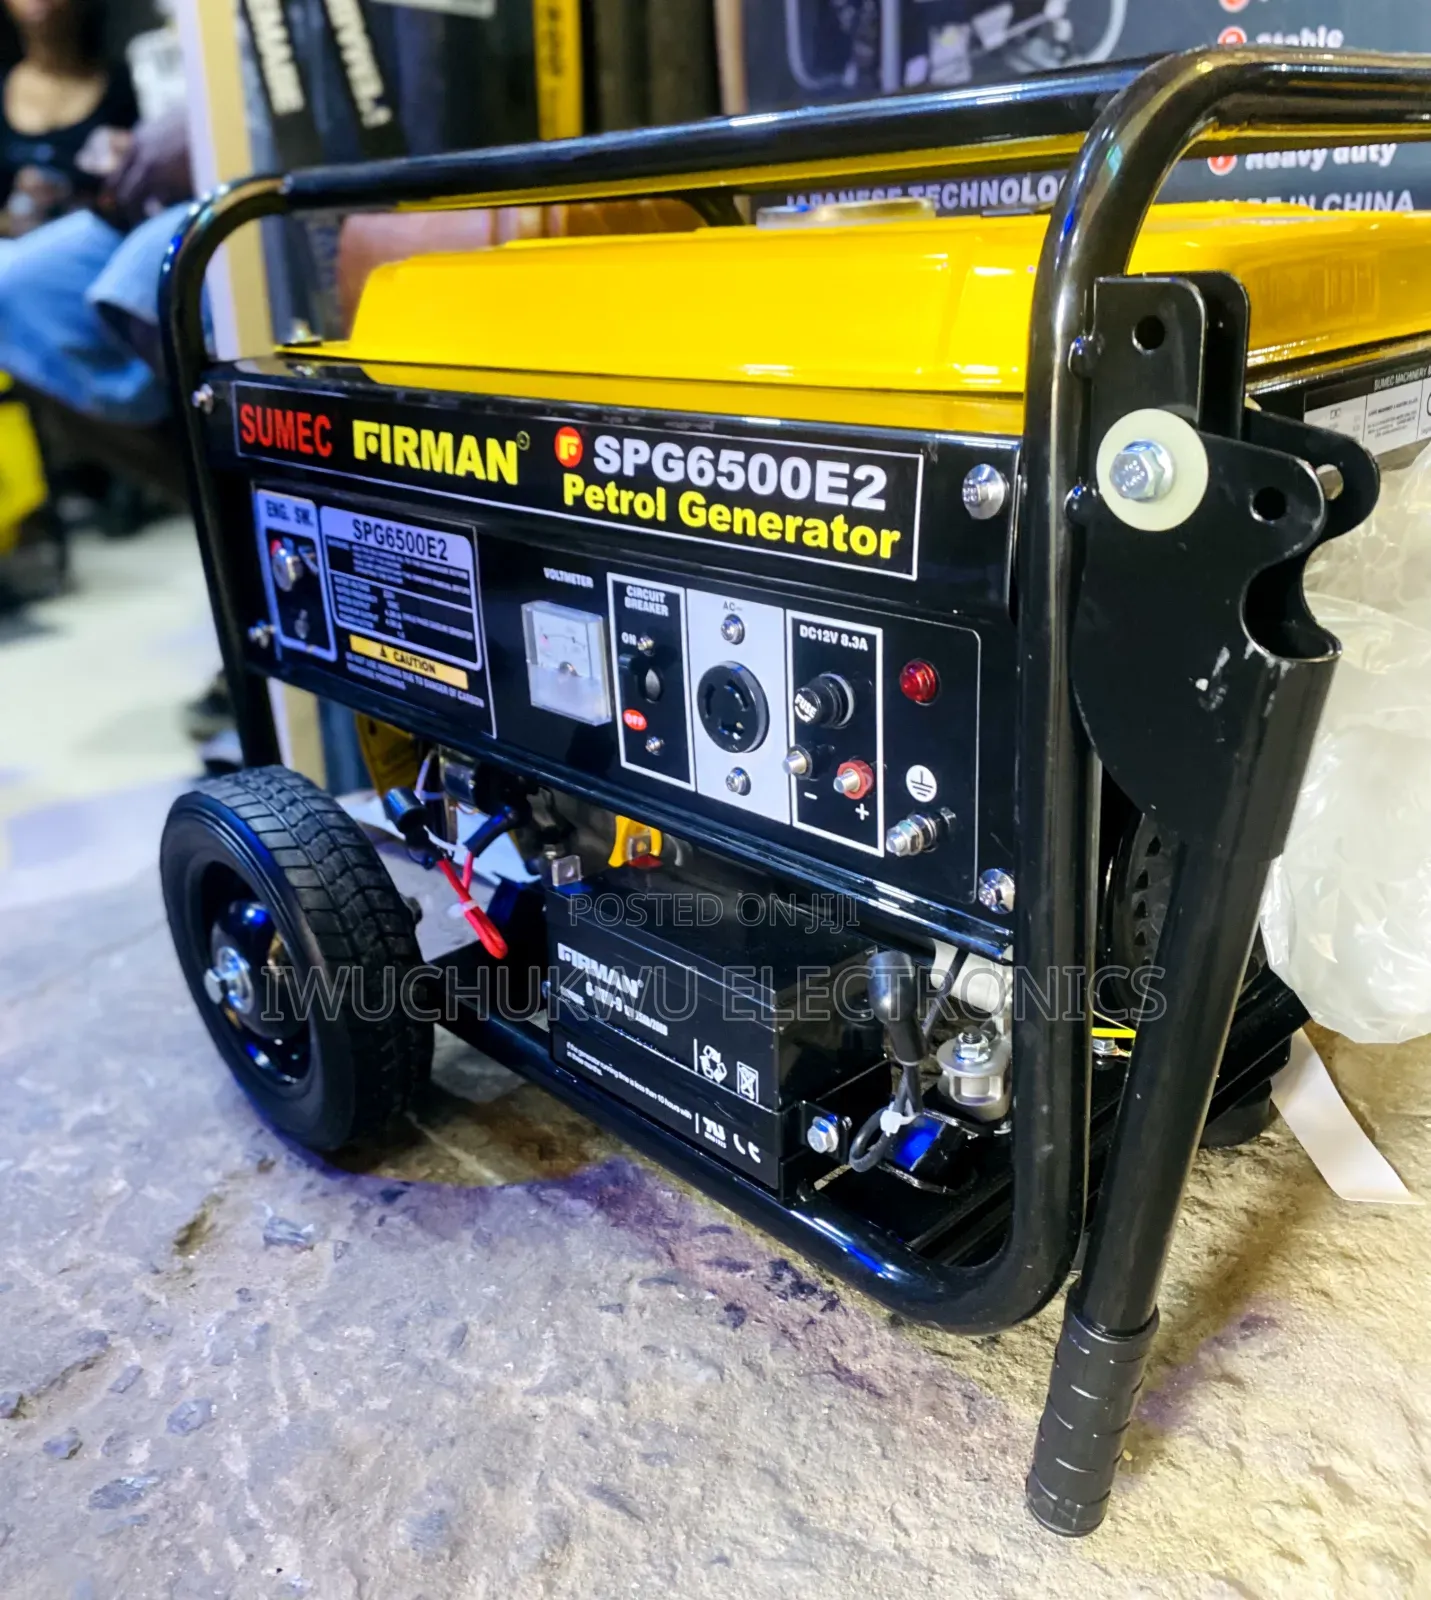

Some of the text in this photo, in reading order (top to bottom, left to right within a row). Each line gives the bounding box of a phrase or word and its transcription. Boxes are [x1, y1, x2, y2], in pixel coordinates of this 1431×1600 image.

[908, 174, 1065, 209] TECHNOLO
[1322, 190, 1414, 212] CHINA
[240, 403, 518, 485] SUMEC FIRMAN
[593, 435, 888, 511] SPG6500E2
[563, 473, 901, 559] Petrol Generator
[352, 518, 449, 561] SPG6500E2
[543, 567, 594, 589] VOLTMETER
[624, 597, 669, 617] BREAKER
[626, 585, 666, 603] CIRCUIT
[621, 631, 637, 646] ON
[800, 624, 869, 651] DC12V 8.3A
[393, 651, 437, 675] CAUTION
[795, 693, 818, 719] FUSE
[625, 712, 645, 727] OFF
[558, 942, 639, 998] FIRMAN
